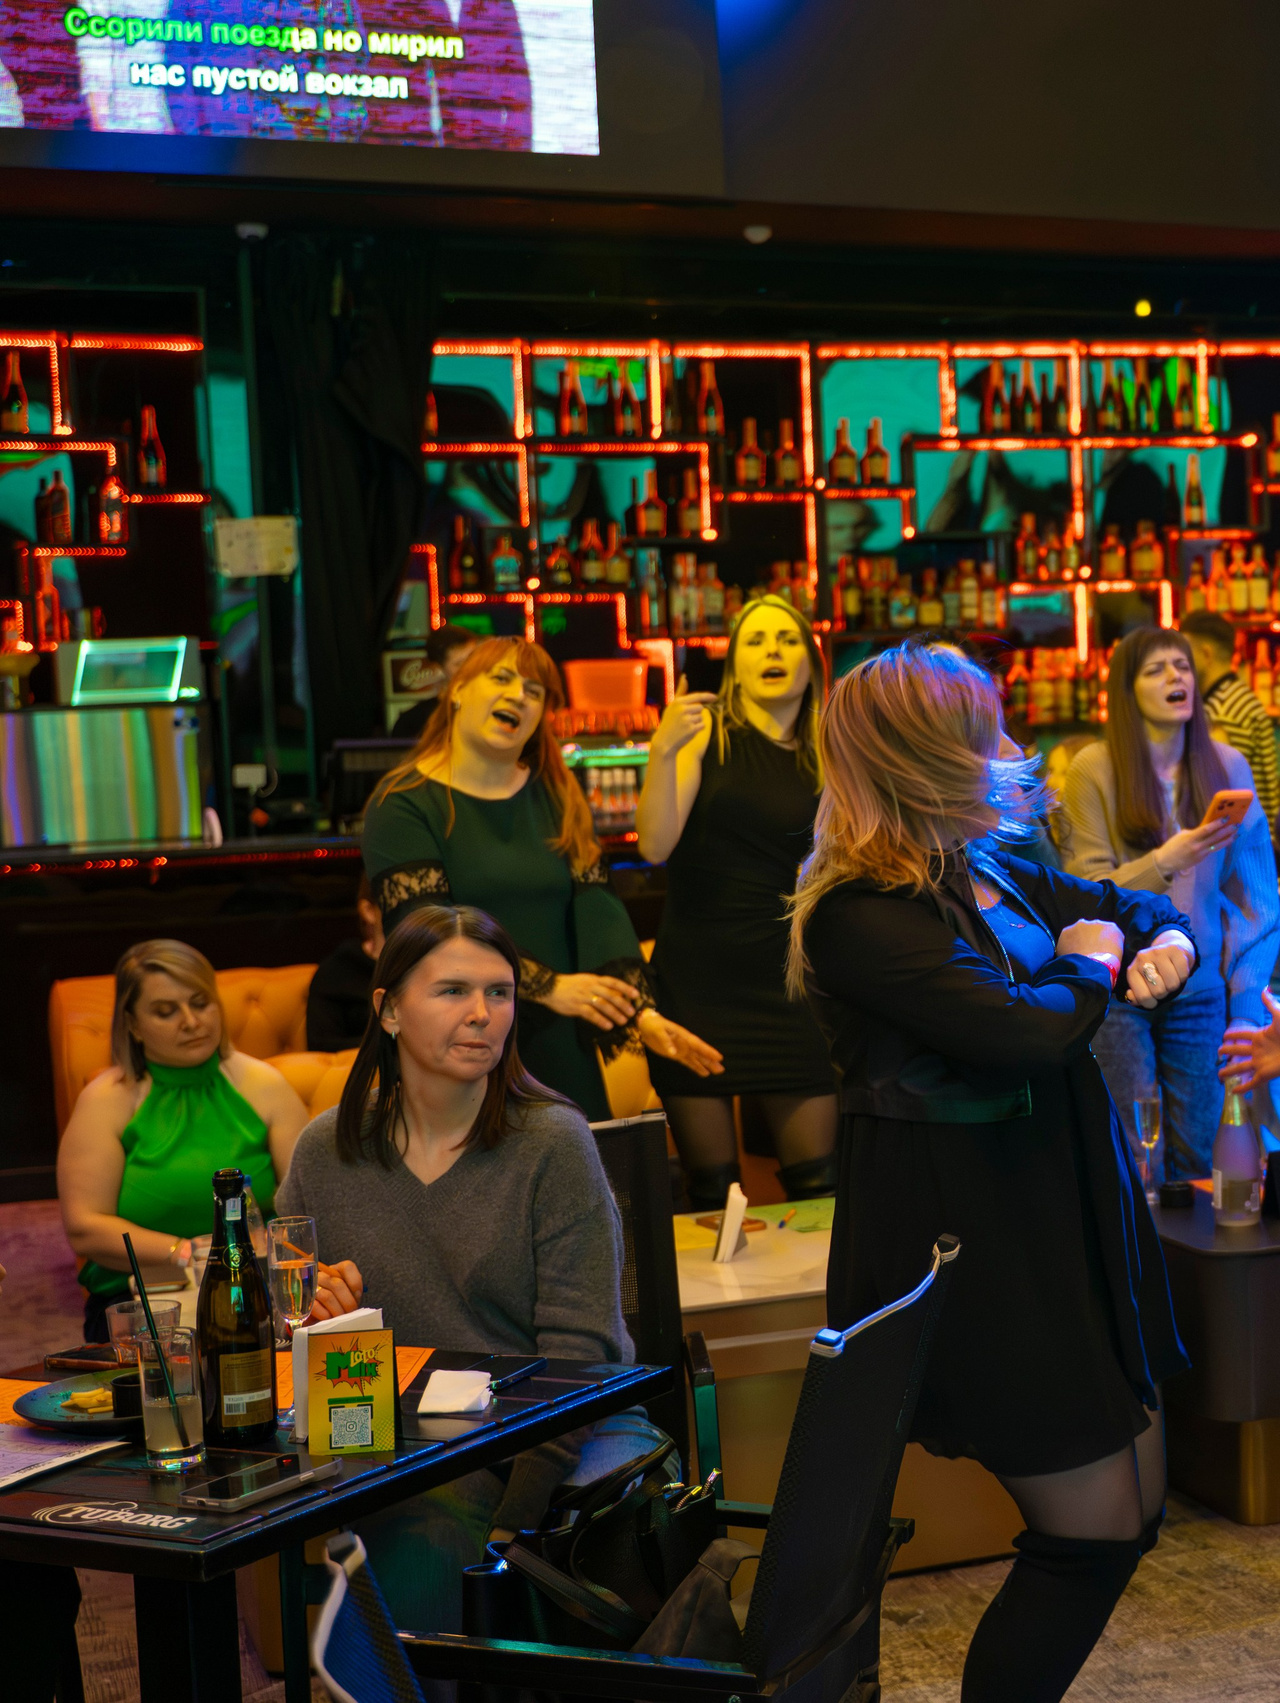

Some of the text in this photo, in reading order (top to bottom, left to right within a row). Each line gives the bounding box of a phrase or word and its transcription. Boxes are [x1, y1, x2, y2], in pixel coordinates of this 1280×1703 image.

[64, 7, 465, 63] Ссорили поезда но мирил
[130, 62, 409, 100] нас пустой вокзал
[68, 1505, 199, 1530] TUBORG
